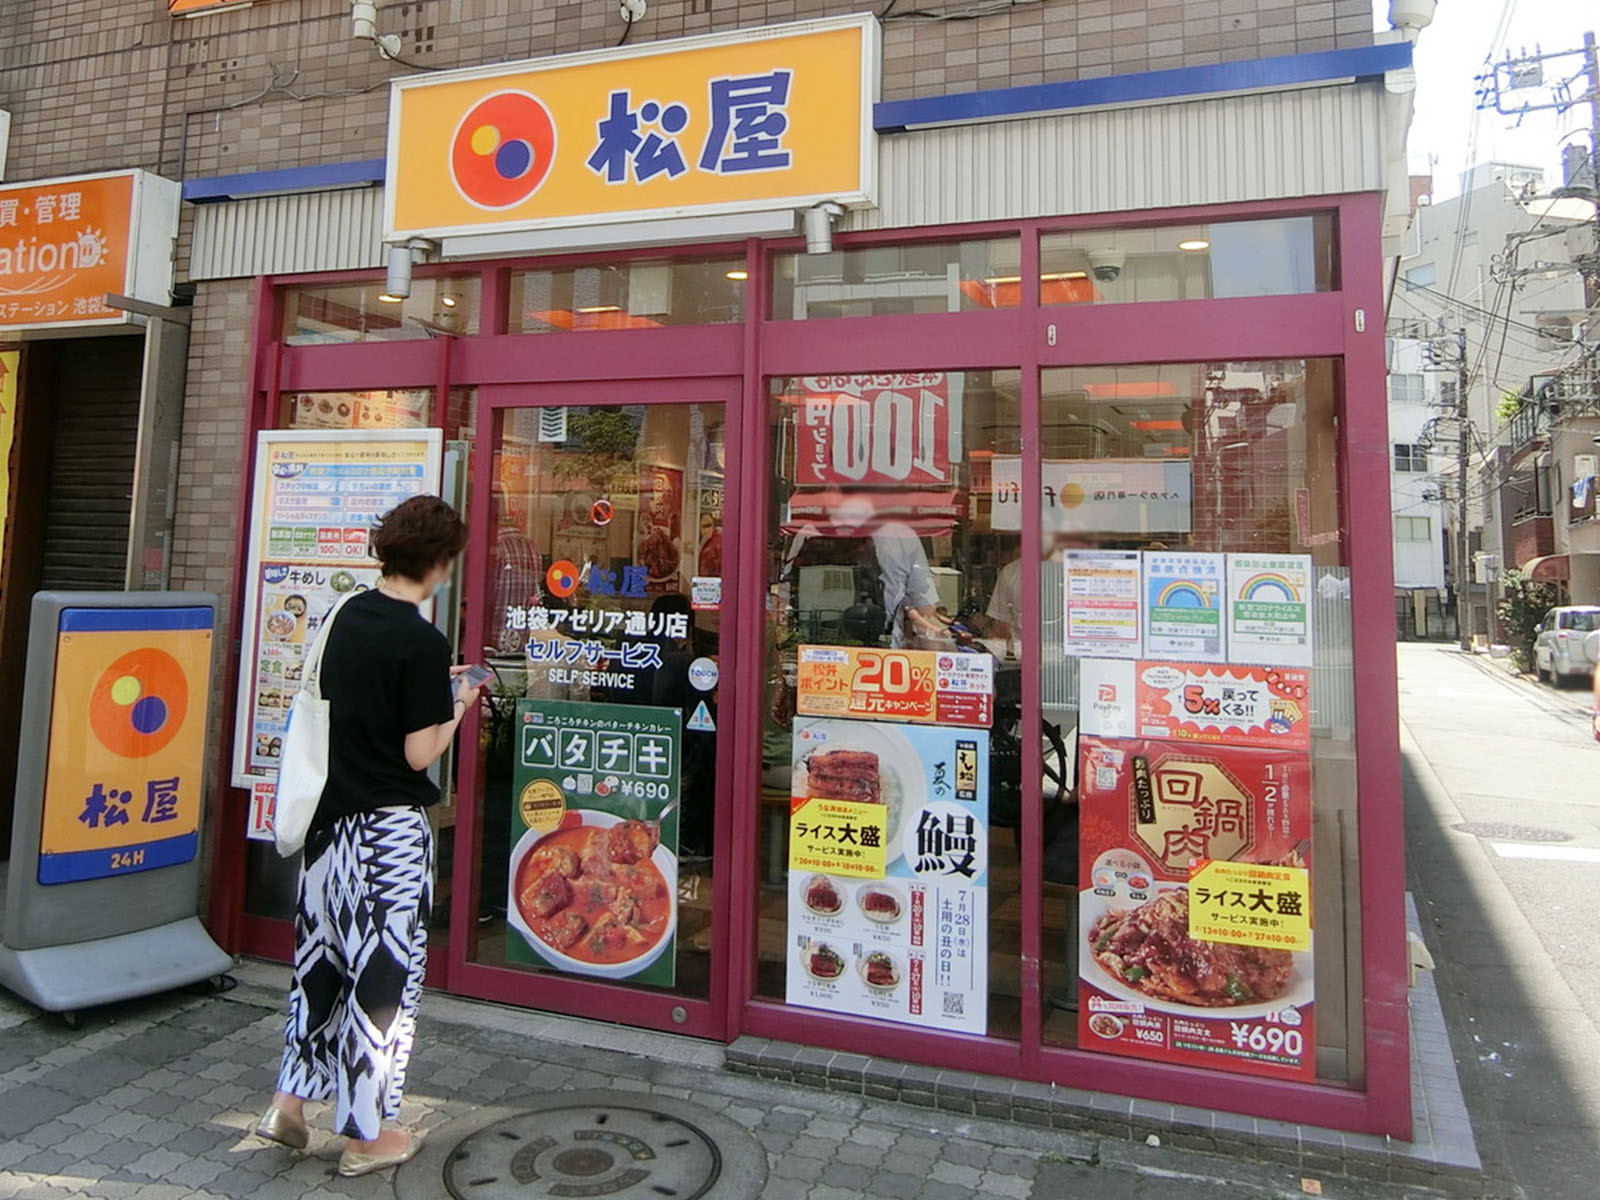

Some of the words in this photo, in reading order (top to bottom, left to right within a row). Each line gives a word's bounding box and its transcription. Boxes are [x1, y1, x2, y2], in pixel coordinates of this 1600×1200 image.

[585, 69, 793, 184] 松屋
[345, 545, 363, 555] OK!
[290, 571, 326, 585] 牛めし
[587, 564, 649, 597] 松屋
[506, 605, 689, 638] 池袋アゼリア通り店
[260, 660, 282, 674] 定食
[525, 638, 663, 670] セルフサービス
[548, 668, 578, 684] SELF
[583, 670, 635, 689] SERVICE
[691, 669, 717, 677] TOUCH
[800, 677, 848, 691] ポイント
[852, 652, 933, 695] 20%
[850, 692, 934, 713] 還元キャンペーン
[1092, 702, 1121, 714] PayPay
[1183, 684, 1220, 715] 5%
[1222, 688, 1259, 702] 戻って
[1222, 702, 1255, 717] くる!!
[526, 734, 667, 773] バタチキ
[79, 777, 180, 828] 松屋
[621, 780, 670, 799] ¥690
[1133, 757, 1154, 821] お肉たっぷり
[1156, 769, 1246, 863] 回鍋肉
[796, 822, 881, 848] ライス大盛
[914, 809, 978, 878] 鰻
[111, 849, 145, 868] 24H
[1195, 887, 1303, 917] ライス大盛
[940, 898, 953, 987] 土用の丑の日!!
[1136, 1028, 1164, 1042] ¥650
[1230, 1021, 1302, 1056] ¥690
